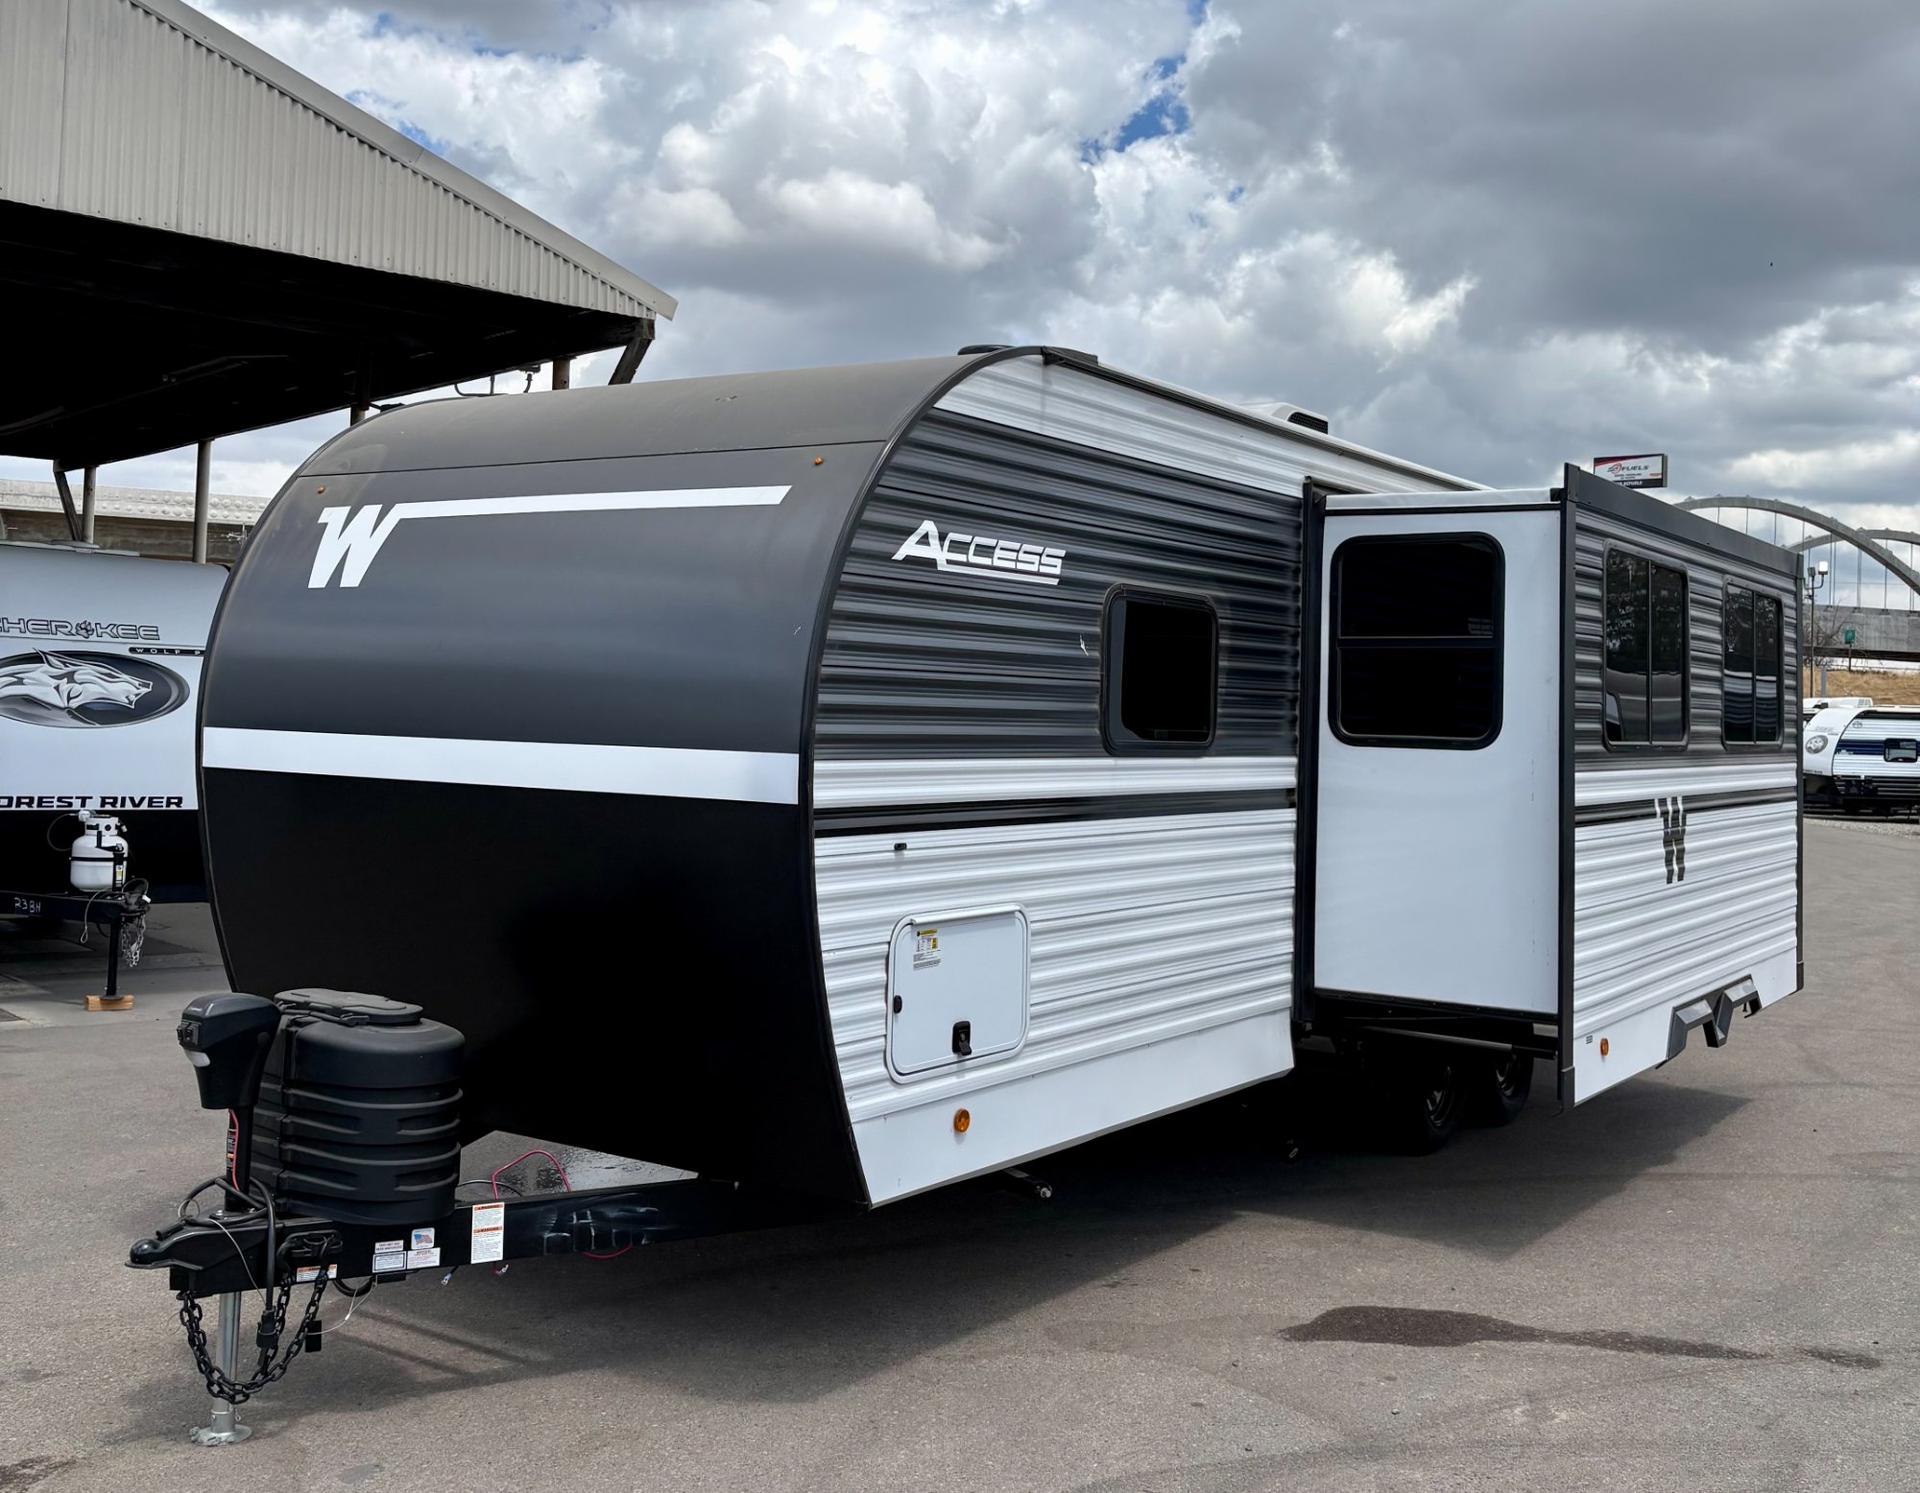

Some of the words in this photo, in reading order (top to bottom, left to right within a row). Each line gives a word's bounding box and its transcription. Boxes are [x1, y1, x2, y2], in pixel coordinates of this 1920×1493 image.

[307, 503, 402, 589] W
[0, 617, 160, 641] HEROKEE
[135, 647, 180, 655] WOLF
[0, 796, 93, 809] OREST
[99, 796, 184, 809] RIVER
